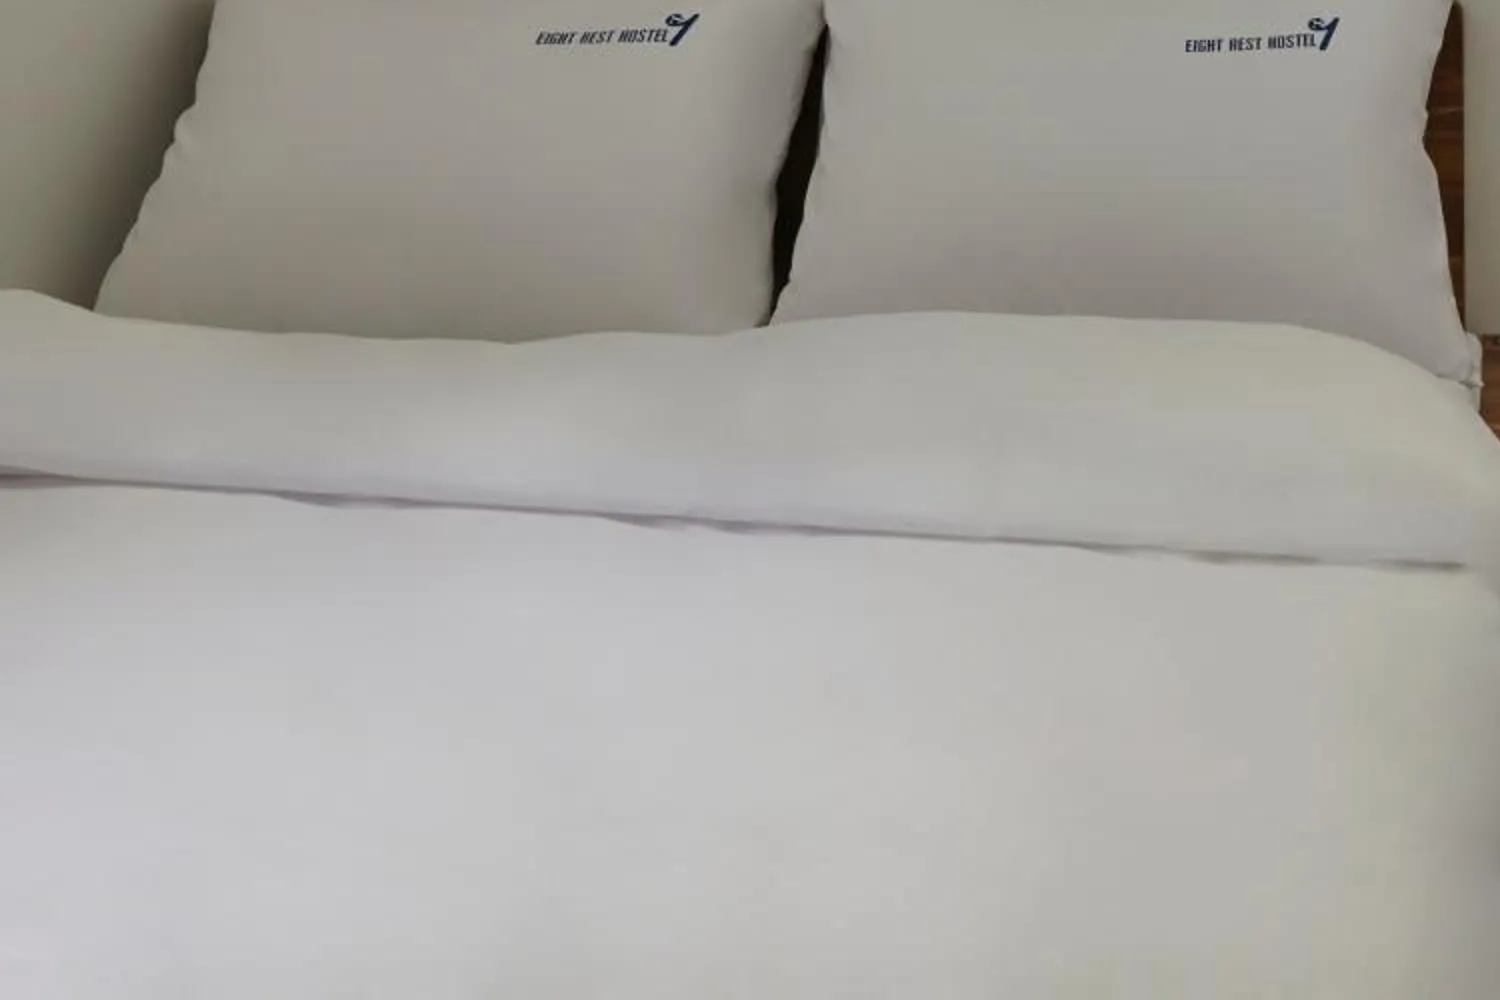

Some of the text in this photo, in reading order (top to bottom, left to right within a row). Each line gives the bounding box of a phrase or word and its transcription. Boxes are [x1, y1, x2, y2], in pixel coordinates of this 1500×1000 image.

[535, 28, 669, 46] EIGHT REST HOSTEL
[1185, 33, 1317, 53] EIGHT REST HOSTEL
